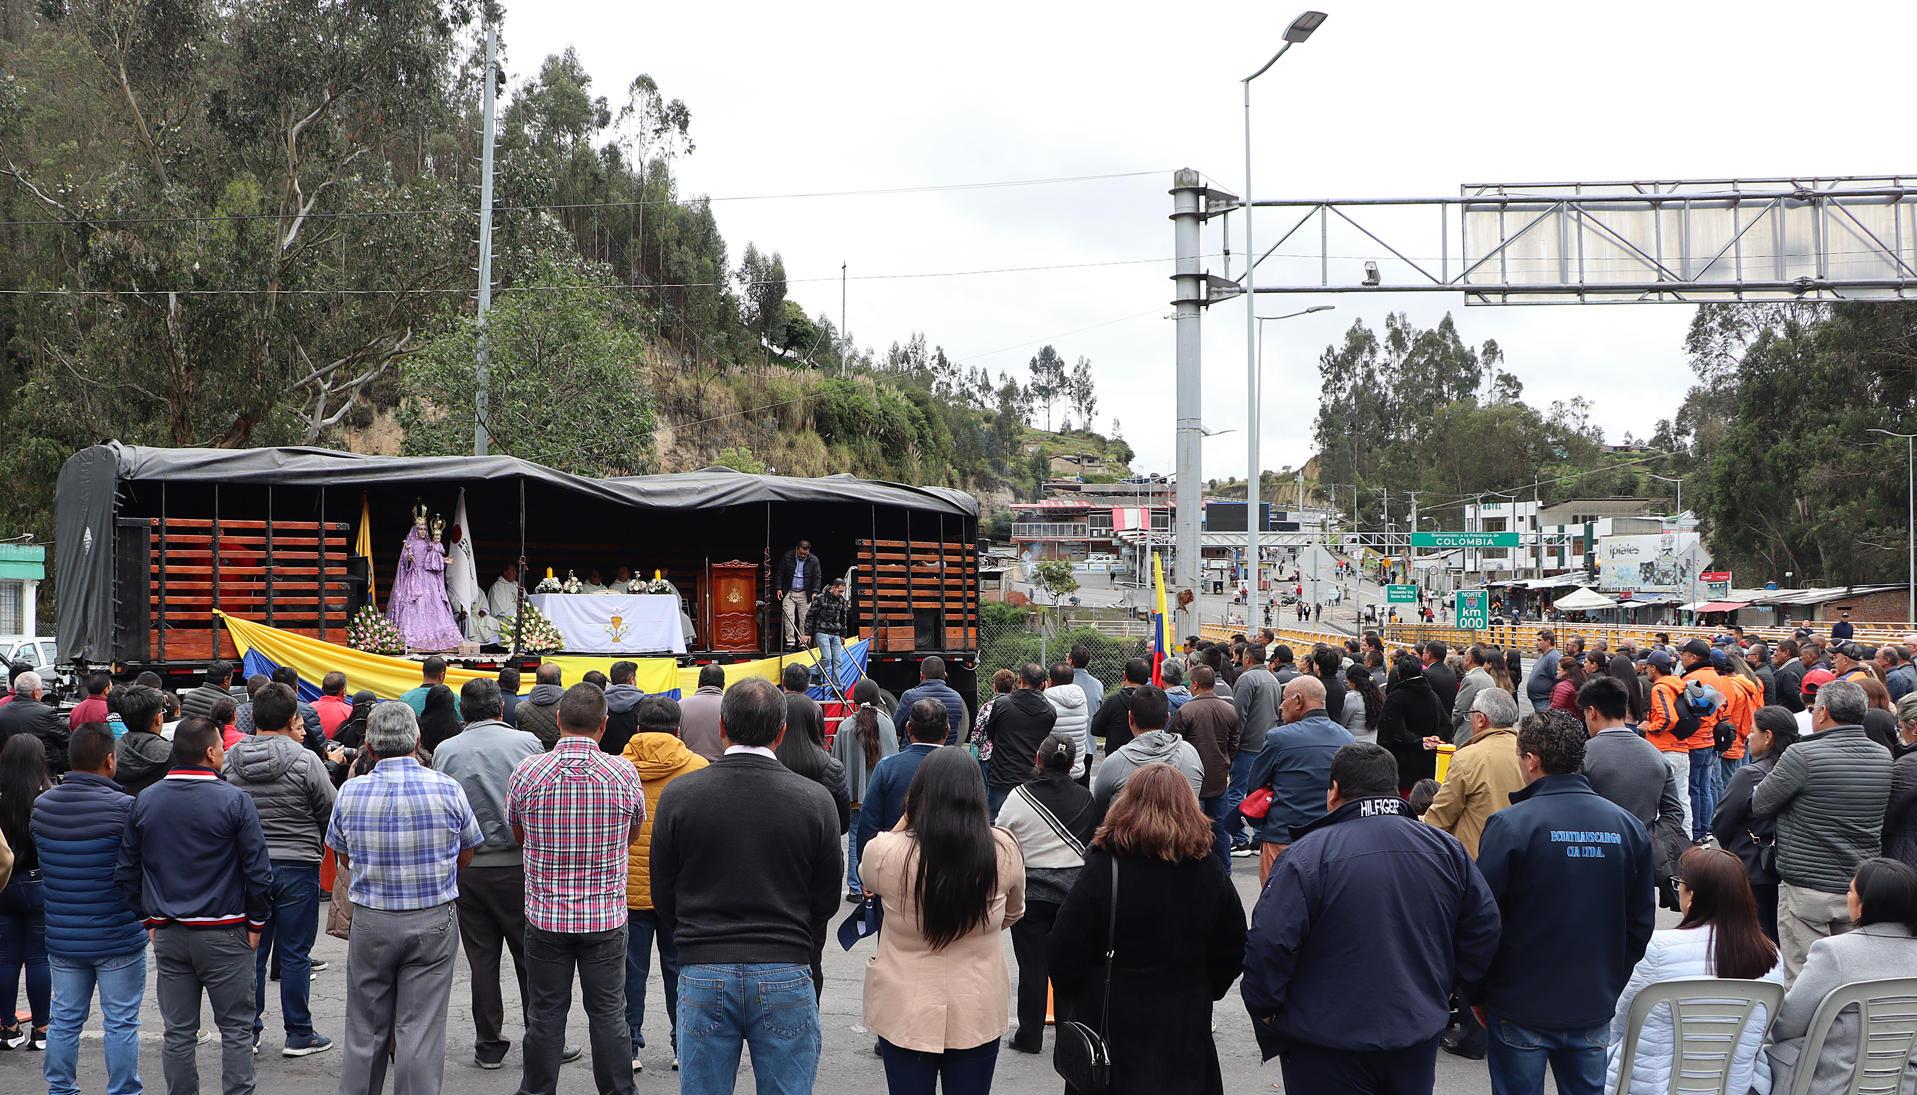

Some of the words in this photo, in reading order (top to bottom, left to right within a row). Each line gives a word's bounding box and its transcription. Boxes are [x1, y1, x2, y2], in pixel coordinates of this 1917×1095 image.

[1436, 538, 1494, 546] COLOMBIA
[1609, 543, 1640, 559] ipiales
[1462, 607, 1481, 617] km
[1460, 617, 1484, 629] 000
[1360, 799, 1399, 817] HILFIGER
